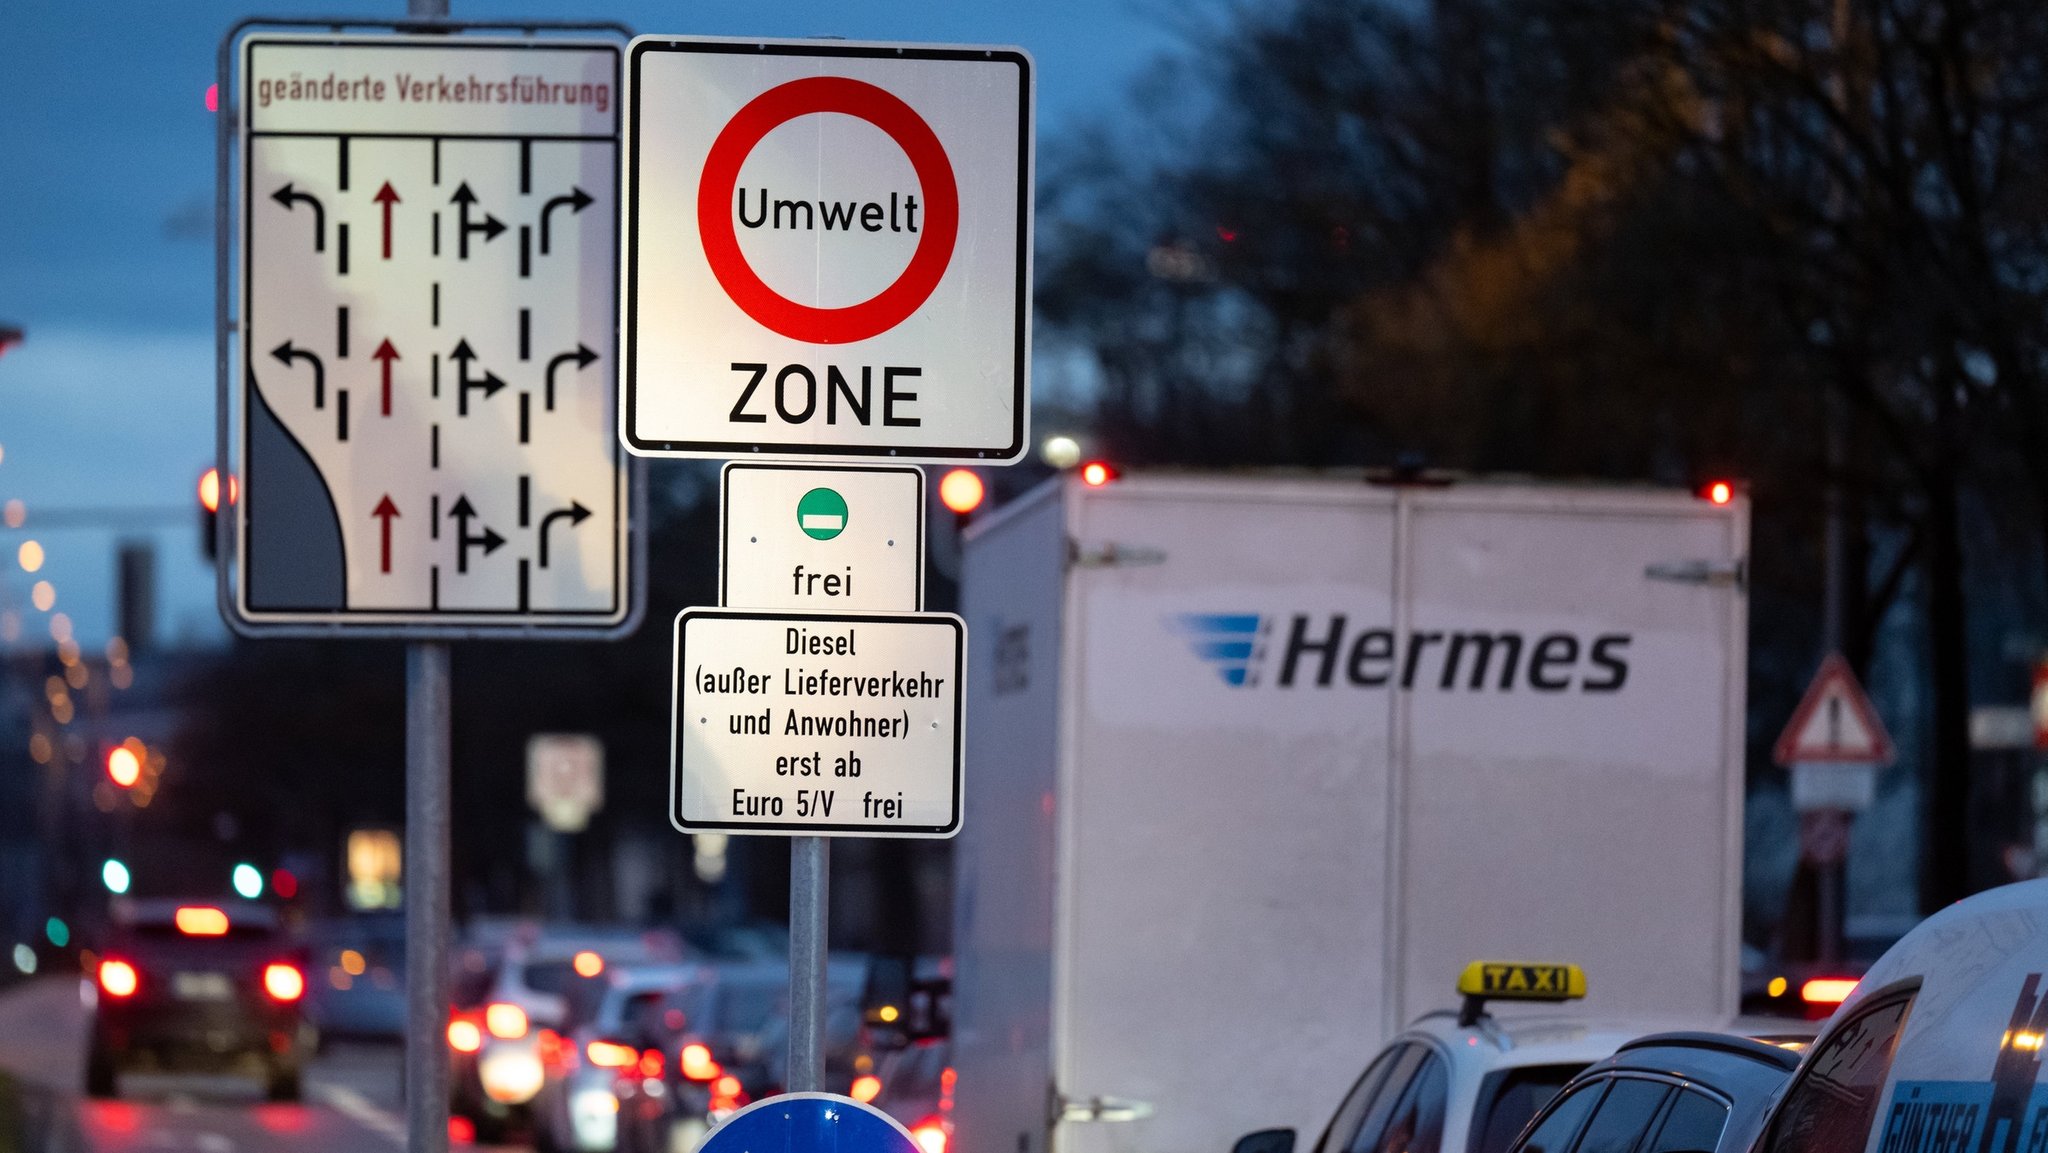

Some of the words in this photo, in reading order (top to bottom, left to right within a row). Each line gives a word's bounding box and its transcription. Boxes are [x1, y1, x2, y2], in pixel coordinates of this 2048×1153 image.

[258, 73, 386, 107] geänderte
[395, 74, 610, 114] Verkehrsführung
[738, 187, 918, 233] Umwelt
[729, 362, 922, 428] ZONE
[792, 565, 851, 597] frei
[786, 627, 856, 656] Diesel
[1277, 614, 1634, 693] Hermes
[695, 664, 771, 695] (außer
[784, 668, 945, 699] Lieferverkehr
[729, 708, 771, 735] und
[784, 708, 909, 740] Anwohner)
[776, 752, 821, 777] erst
[834, 750, 861, 778] ab
[732, 788, 783, 816] Euro
[796, 790, 835, 818] 5/V
[863, 791, 903, 819] frei
[1486, 966, 1567, 991] TAXI
[1882, 1086, 1980, 1153] GÜNTHER
